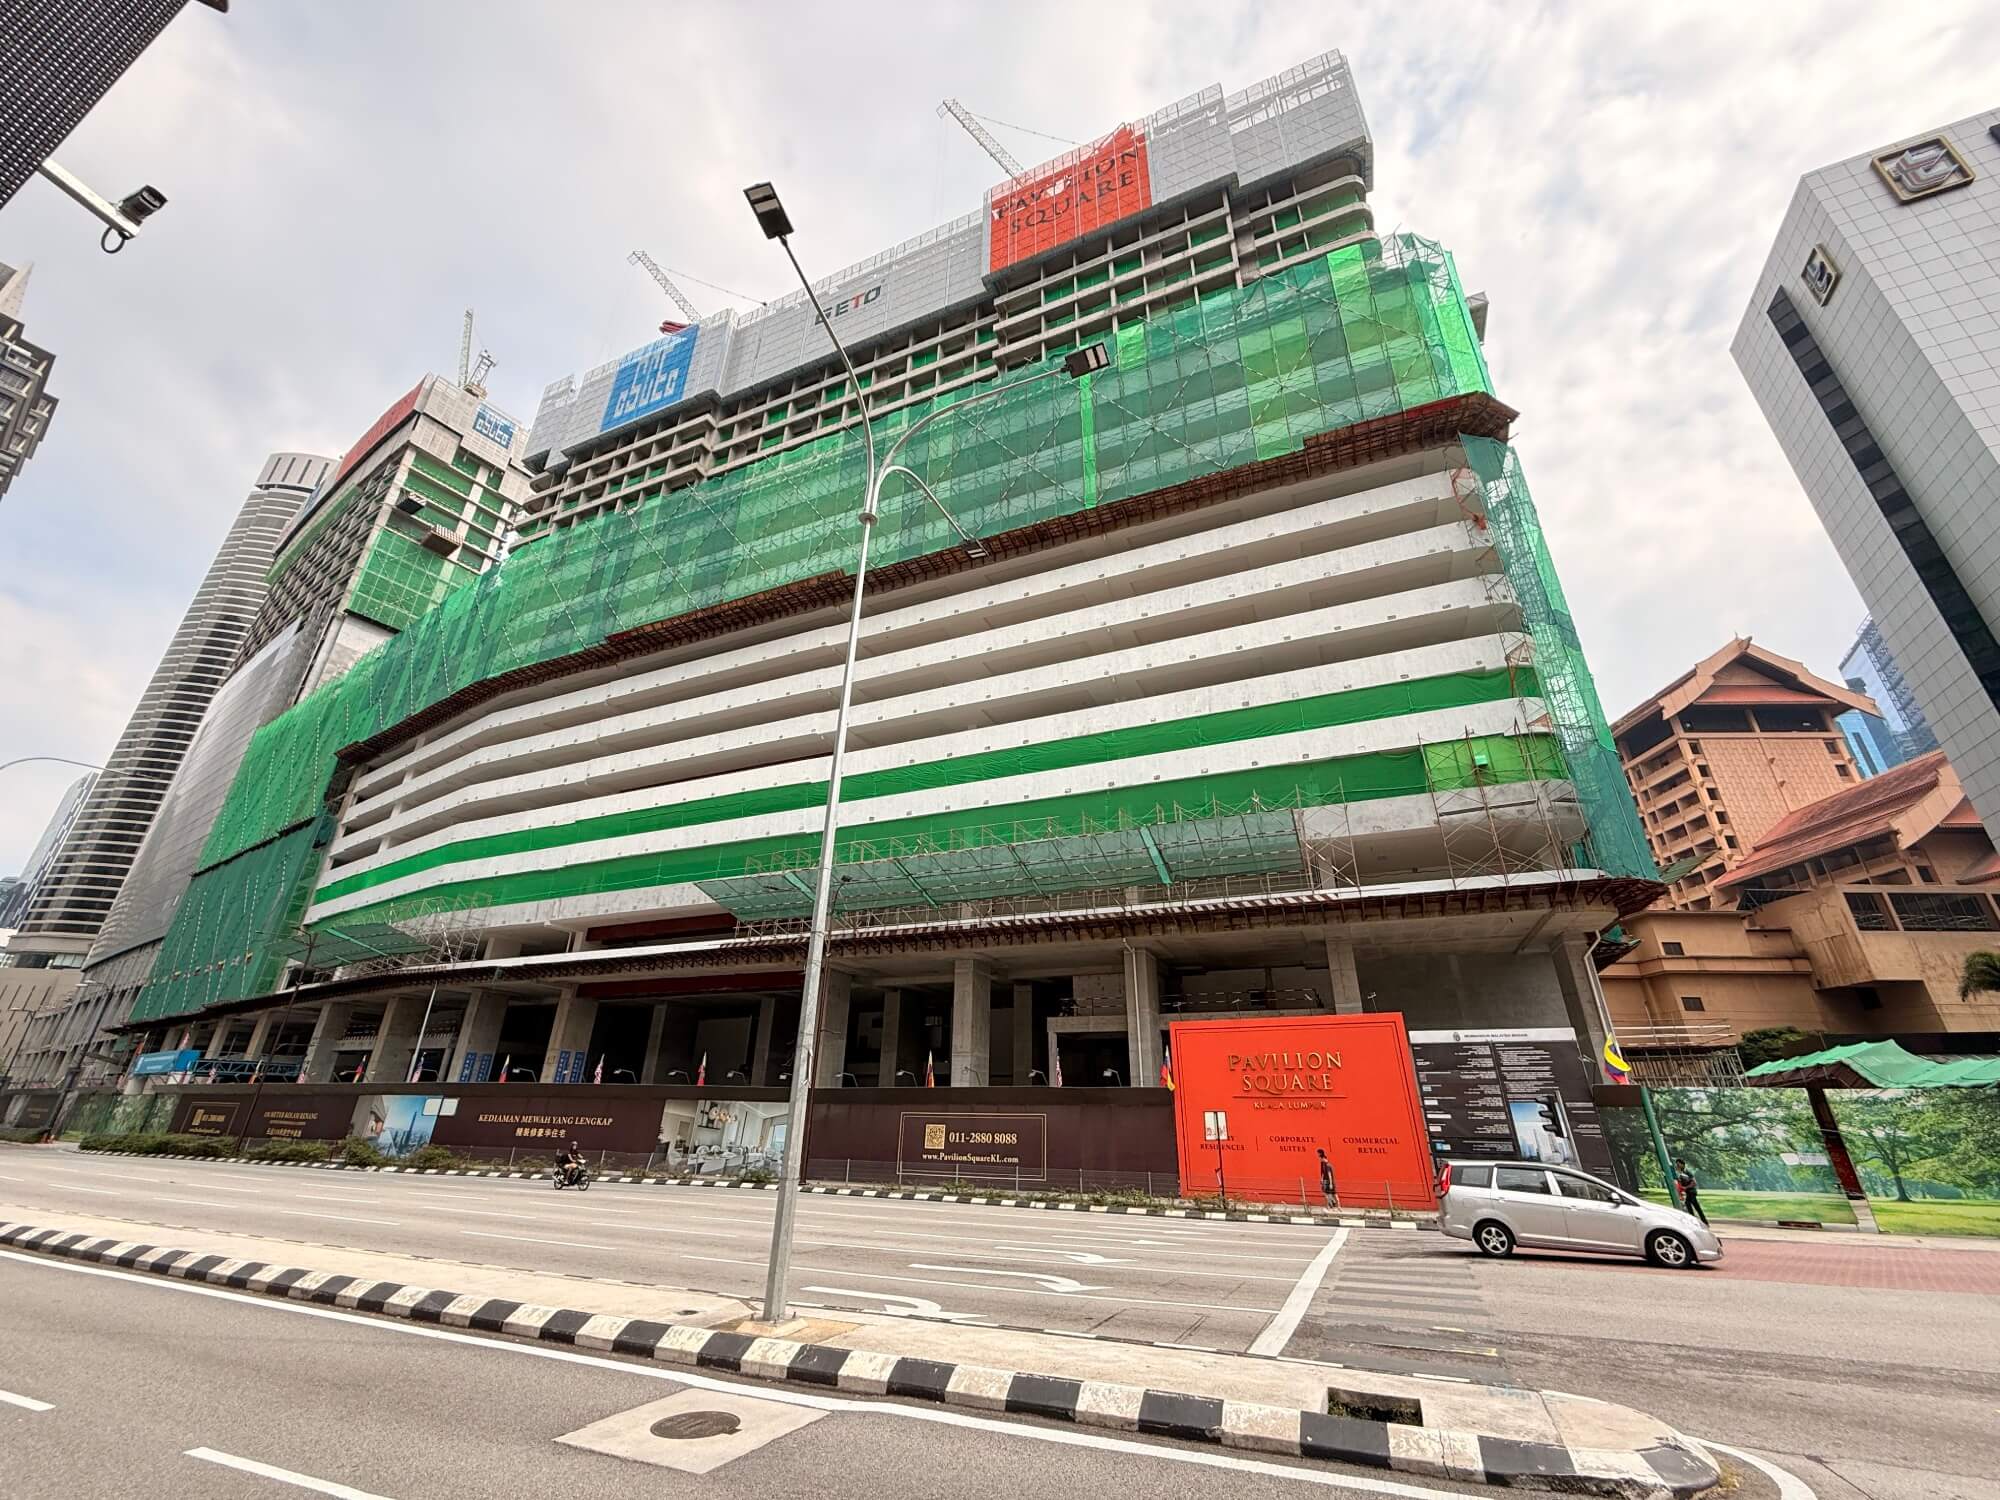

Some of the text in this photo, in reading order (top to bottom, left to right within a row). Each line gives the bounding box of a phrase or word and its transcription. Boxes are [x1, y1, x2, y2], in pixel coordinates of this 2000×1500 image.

[997, 147, 1138, 219] PAVION
[1011, 170, 1136, 235] SQUARE
[1228, 1051, 1343, 1071] PAVILION
[1242, 1073, 1334, 1095] SQUARE
[478, 1114, 613, 1126] KEDIAMAN MEWAH YANG LENGKAP
[948, 1132, 1018, 1144] 011-2880 8088
[1269, 1135, 1317, 1143] CORPORATE
[922, 1152, 1019, 1164] www.PavilionSquareKL.com
